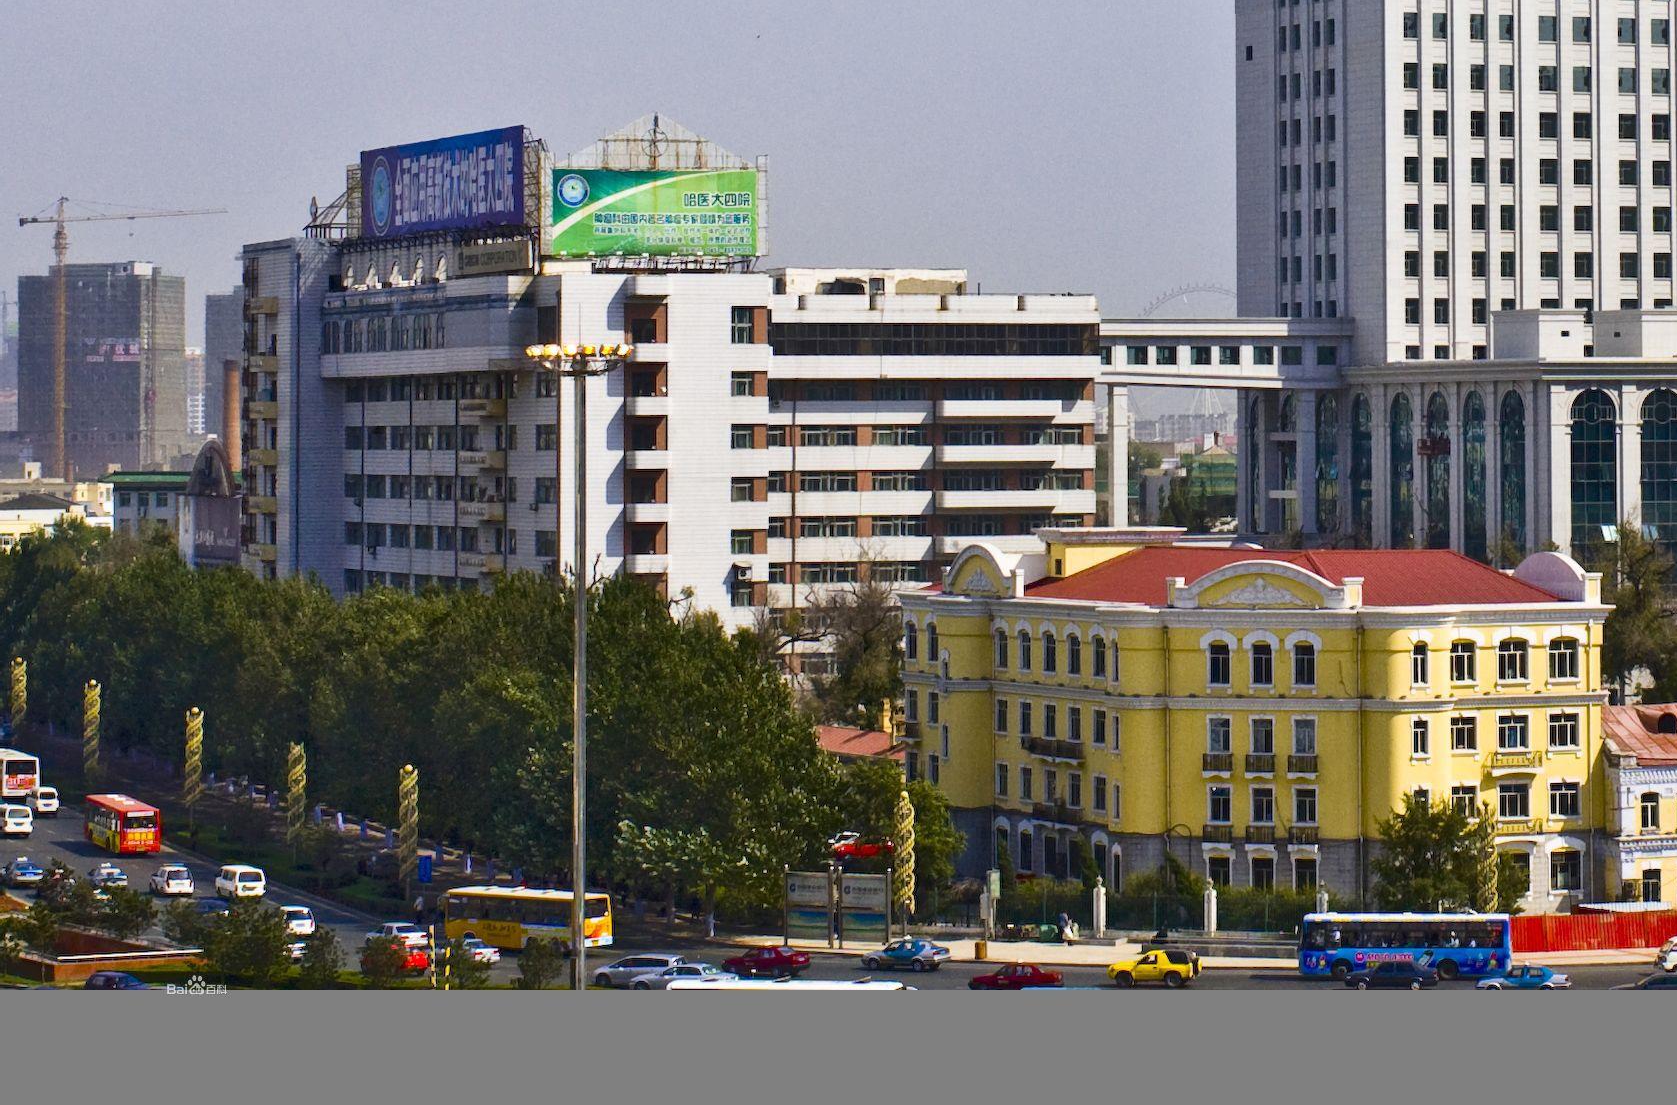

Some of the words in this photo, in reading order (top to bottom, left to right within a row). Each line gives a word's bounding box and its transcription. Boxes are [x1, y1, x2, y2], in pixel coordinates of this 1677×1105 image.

[683, 192, 751, 208] 哈医大四院
